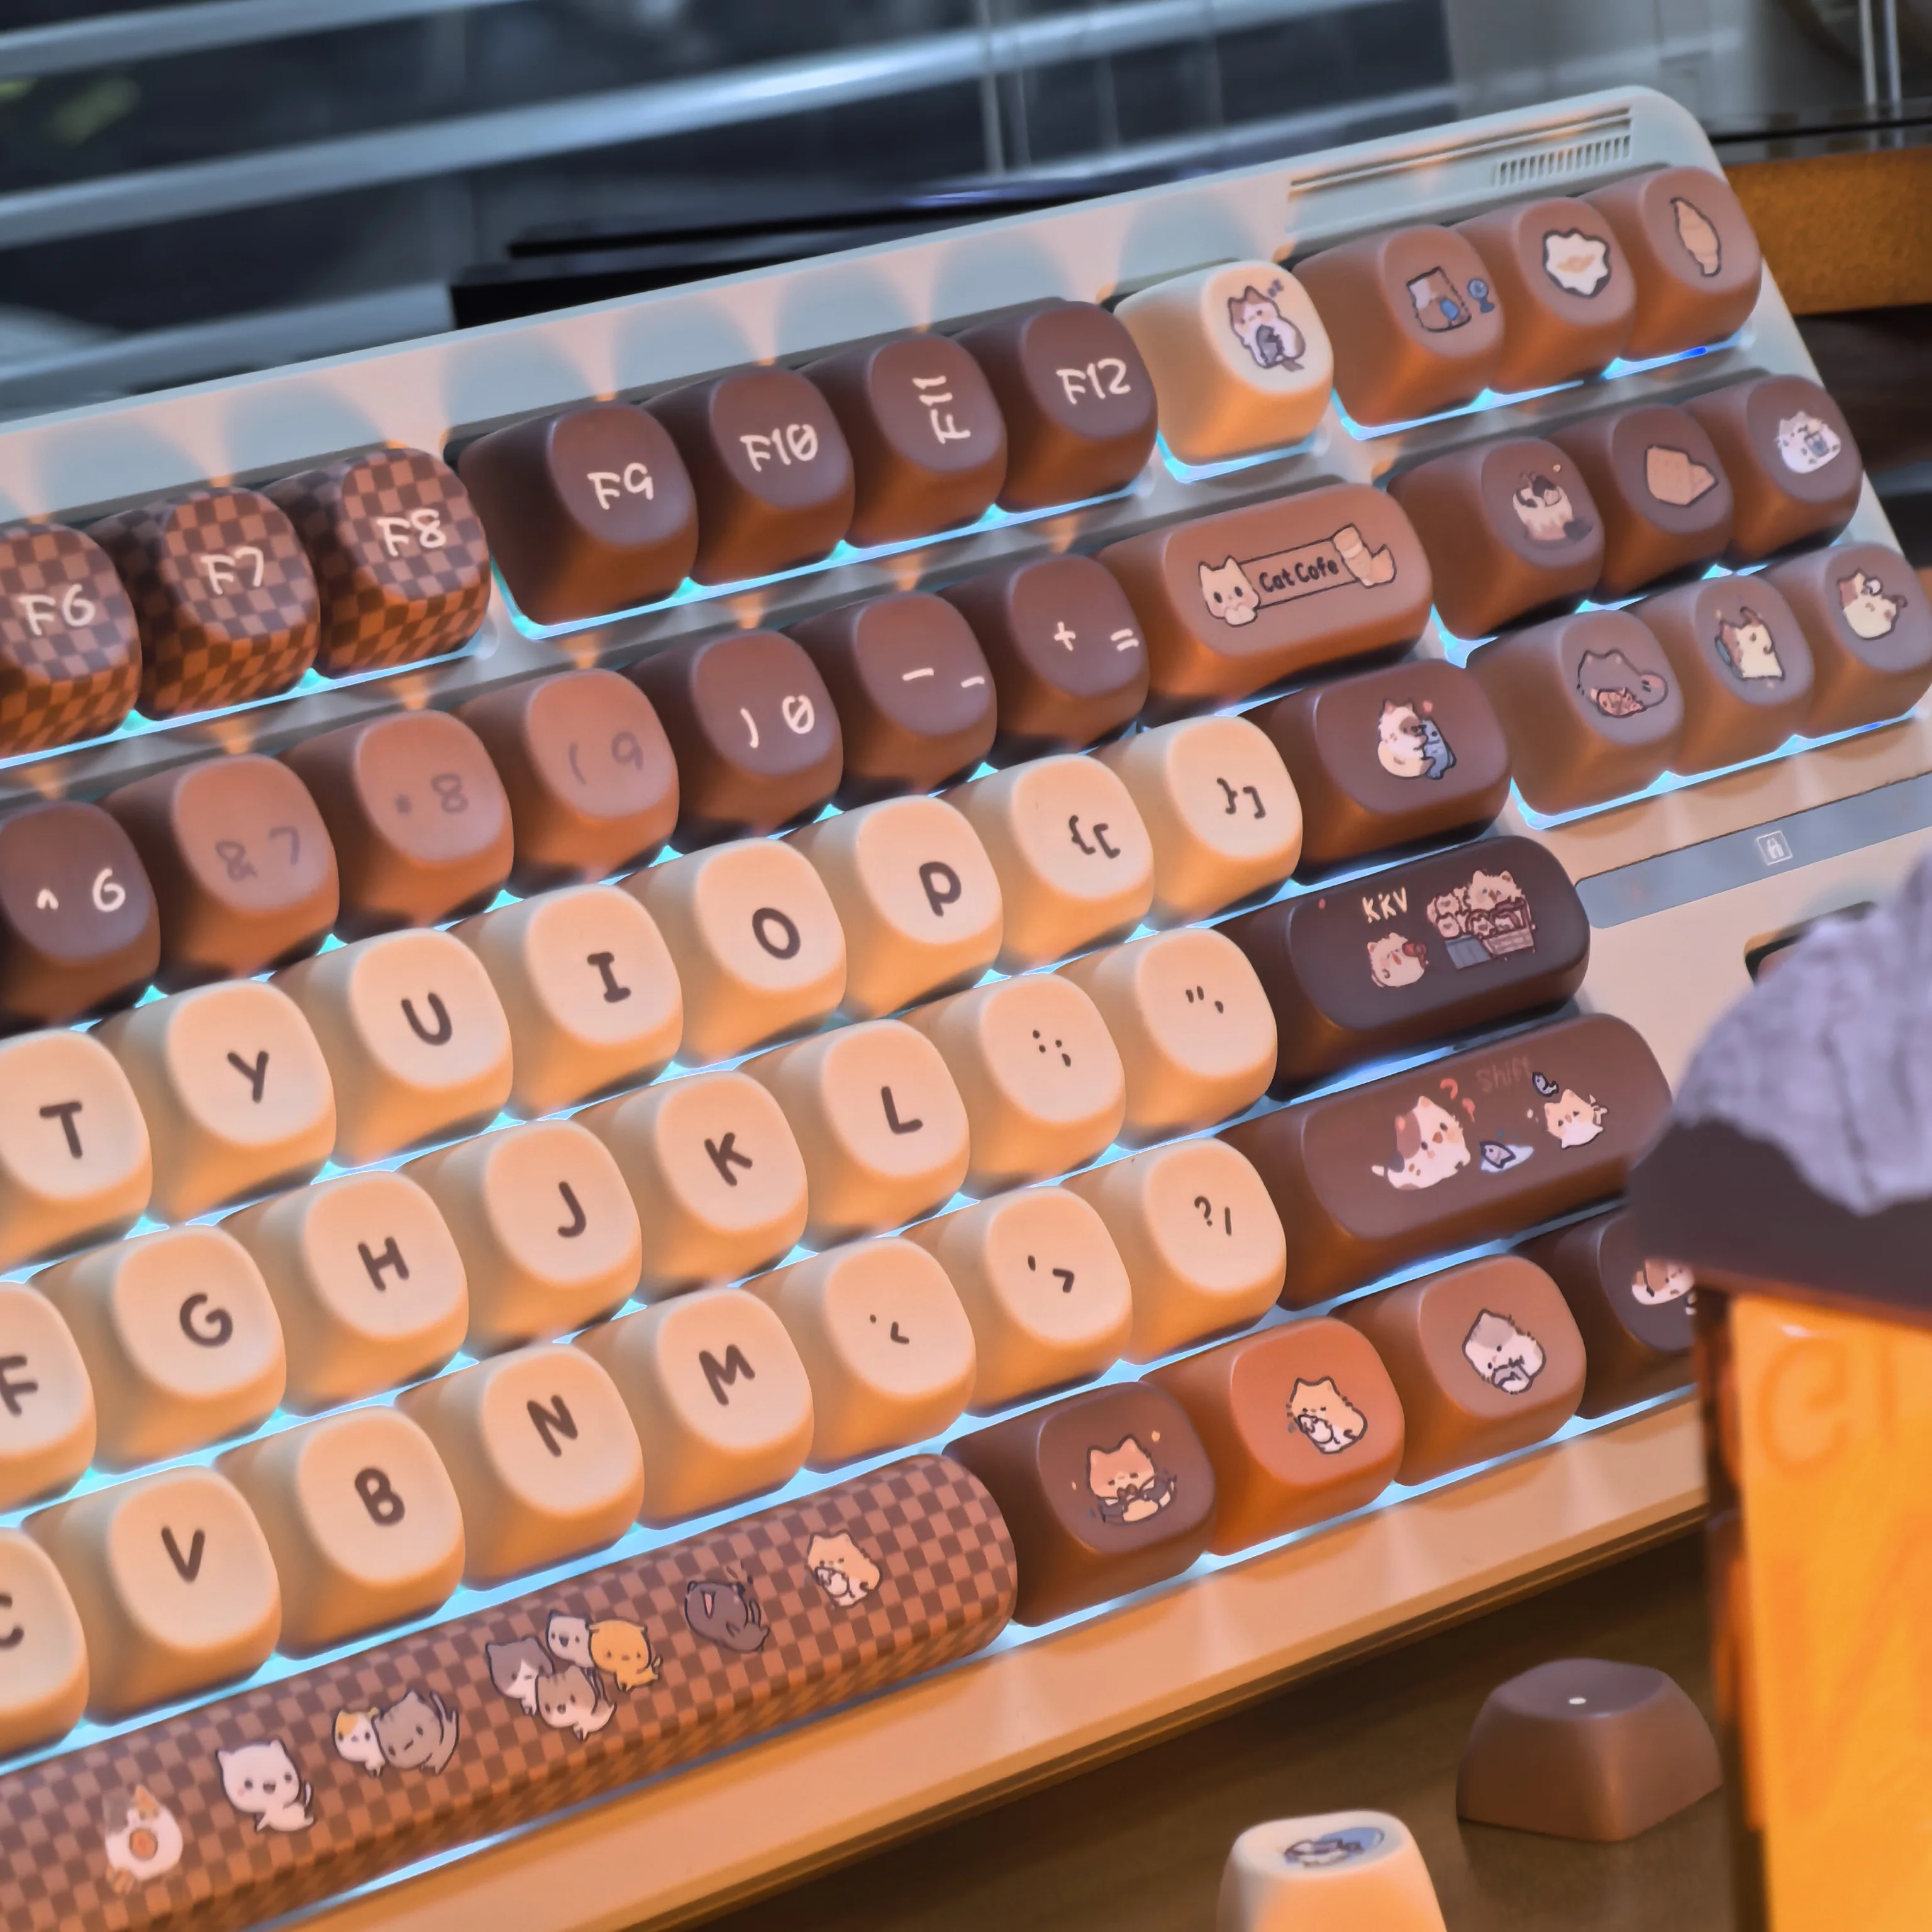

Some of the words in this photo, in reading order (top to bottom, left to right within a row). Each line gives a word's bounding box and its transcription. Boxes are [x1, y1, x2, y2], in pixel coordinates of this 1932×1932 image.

[1057, 358, 1130, 404] F12
[913, 376, 970, 443] F11
[740, 425, 818, 472] F10
[587, 463, 653, 509] F9
[376, 509, 446, 556] F8
[201, 547, 264, 594] F7
[1259, 569, 1295, 592] Cat
[18, 584, 96, 635] F6
[1054, 622, 1075, 651] +
[1111, 629, 1138, 651] =
[782, 696, 814, 734] 0
[611, 732, 643, 770] 9
[431, 774, 469, 813] 8
[269, 826, 300, 865] 7
[92, 869, 125, 911] 6
[919, 862, 961, 916] P
[752, 908, 800, 959] O
[587, 952, 631, 1002] I
[401, 992, 452, 1045] U
[227, 1051, 269, 1102] Y
[40, 1101, 82, 1158] T
[881, 1086, 923, 1134] L
[704, 1133, 752, 1186] K
[558, 1182, 586, 1238] J
[358, 1237, 409, 1291] H
[180, 1293, 233, 1347] G
[699, 1345, 755, 1406] M
[527, 1396, 578, 1457] N
[355, 1468, 404, 1526] B
[161, 1527, 205, 1582] V
